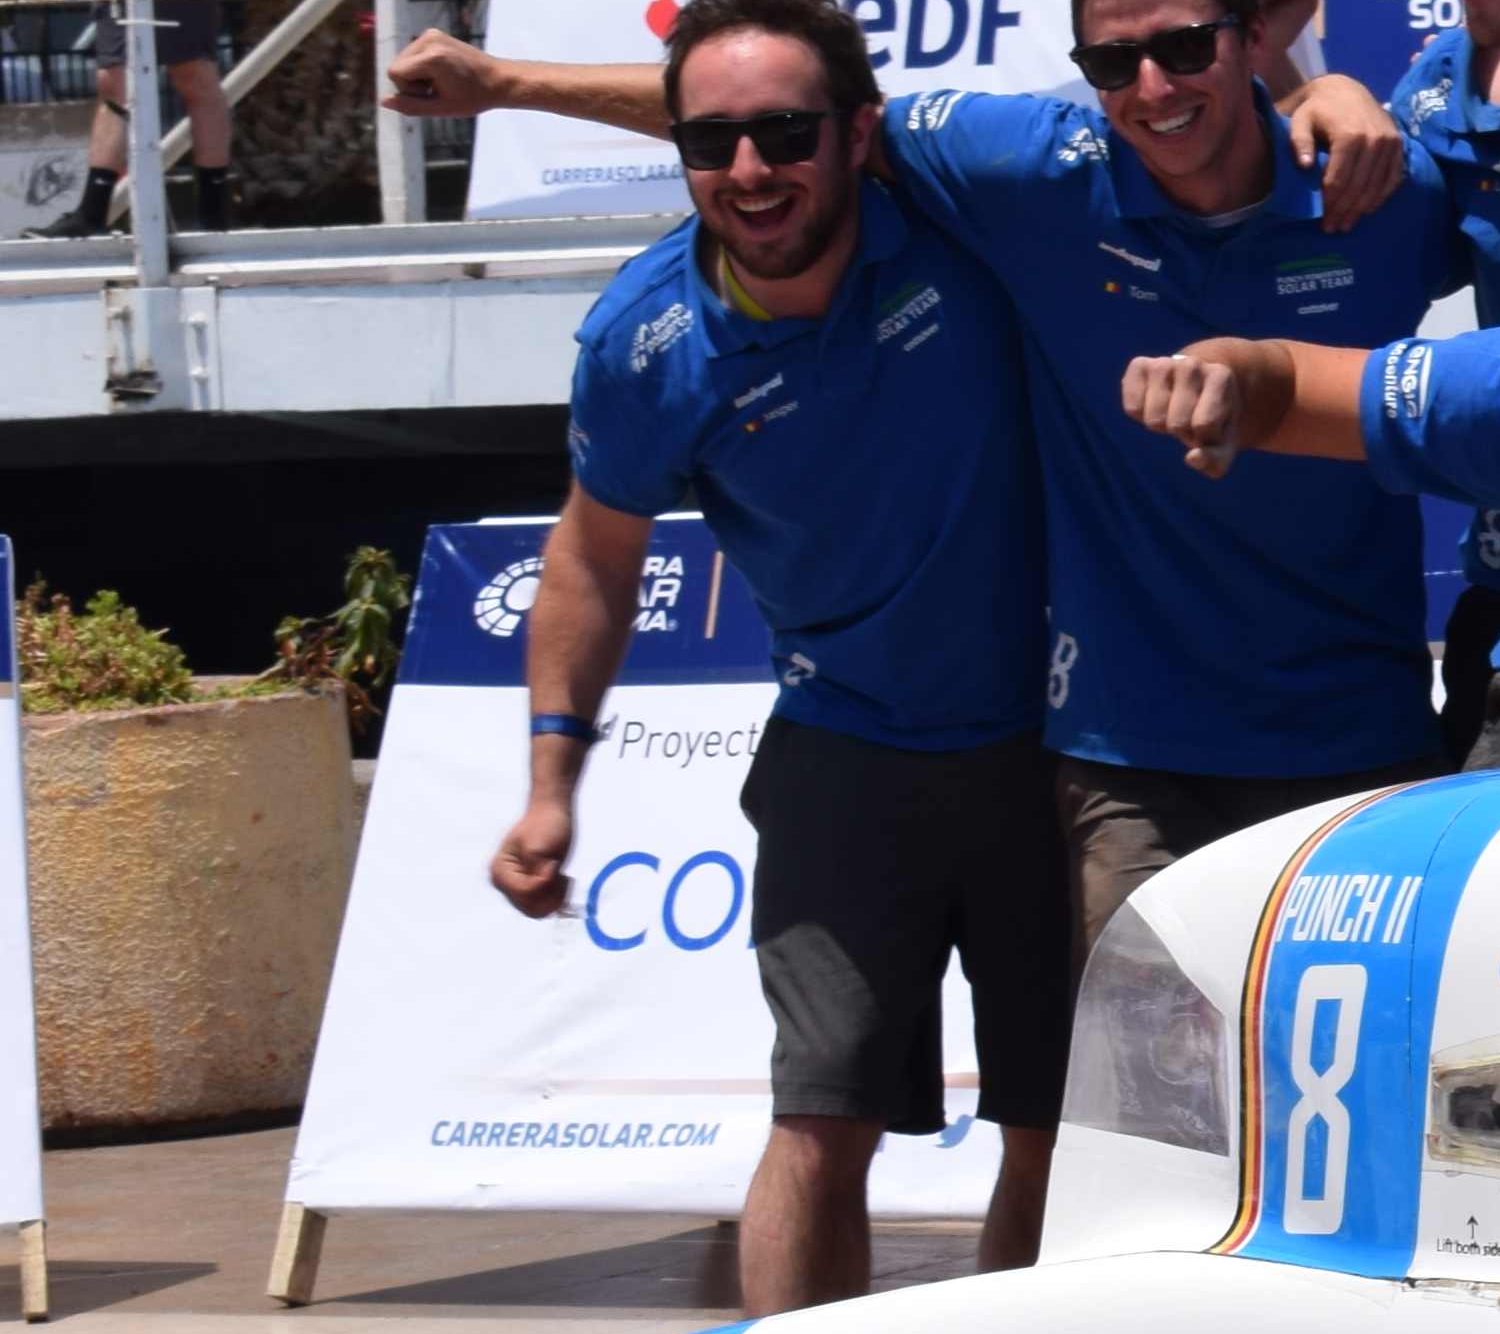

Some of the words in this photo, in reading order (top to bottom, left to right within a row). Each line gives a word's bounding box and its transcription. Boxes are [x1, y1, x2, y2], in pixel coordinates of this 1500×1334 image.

[619, 720, 763, 769] Proyect
[1275, 874, 1393, 944] PUNCH
[1282, 963, 1369, 1236] 8
[430, 1120, 721, 1149] CARRERASOLAR.COM
[1436, 1237, 1453, 1254] Lift
[1455, 1239, 1481, 1255] both
